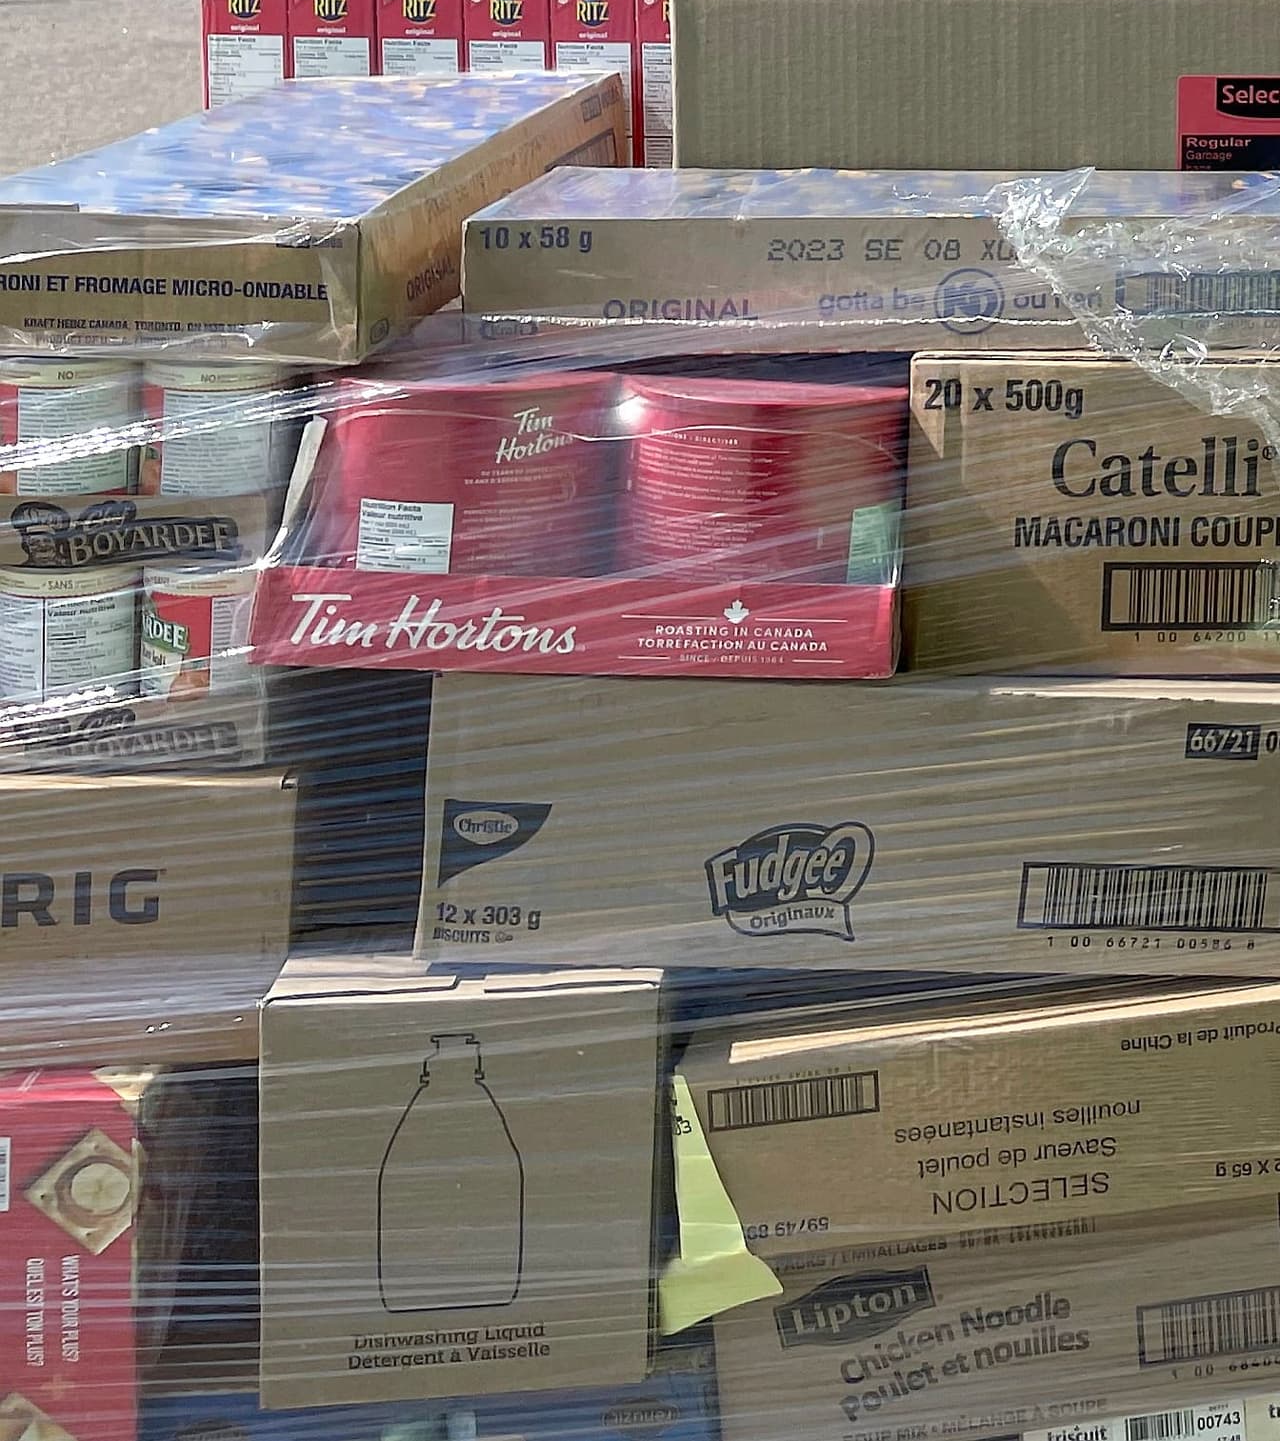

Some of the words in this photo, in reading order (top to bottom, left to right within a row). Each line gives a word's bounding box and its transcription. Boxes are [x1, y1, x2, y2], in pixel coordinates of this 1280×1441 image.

[576, 0, 609, 23] RITZ
[231, 25, 260, 33] original
[317, 27, 346, 35] original
[405, 28, 434, 36] original
[579, 31, 608, 39] original
[1186, 137, 1251, 148] Regular
[480, 227, 509, 249] 10
[519, 231, 531, 248] x
[540, 226, 569, 248] 58
[580, 231, 593, 253] g
[768, 239, 844, 261] 2023
[865, 239, 904, 261] SE
[925, 239, 960, 261] 08
[46, 275, 69, 292] ET
[75, 276, 166, 295] FROMAGE
[172, 279, 328, 300] MICRO-ONDABLE
[603, 298, 759, 321] ORIGINAL
[818, 290, 884, 317] gotta
[1013, 293, 1047, 309] ou
[57, 370, 74, 380] NO
[200, 373, 216, 383] NO
[924, 379, 962, 411] 20
[973, 387, 994, 411] x
[1005, 379, 1084, 419] 500g
[513, 407, 553, 435] Tim
[496, 434, 574, 464] Hortons
[1051, 436, 1263, 499] Catelli
[1015, 516, 1180, 548] MACARONI
[48, 580, 73, 590] SANS
[292, 593, 376, 647] Tim
[384, 594, 578, 655] Hortons
[655, 625, 729, 637] ROASTING
[734, 626, 748, 637] IN
[754, 627, 813, 638] CANADA
[748, 641, 767, 651] AU
[770, 641, 828, 652] CANADA
[1193, 631, 1246, 642] 64200
[679, 654, 710, 663] SINCE
[721, 655, 758, 664] DEPUIS
[1189, 726, 1257, 754] 66721
[458, 815, 513, 835] Christie
[436, 903, 457, 924] 12
[463, 910, 476, 925] x
[483, 904, 522, 926] 303
[528, 909, 541, 931] g
[750, 906, 835, 930] Originaux
[433, 926, 491, 943] BISCUITS
[1071, 936, 1092, 948] 00
[1106, 936, 1161, 949] 66721
[1121, 1032, 1172, 1051] Chine
[1178, 1030, 1192, 1046] la
[1197, 1025, 1217, 1042] de
[1053, 1098, 1141, 1125] nouilles
[894, 1112, 1045, 1144] instantanées
[998, 1147, 1027, 1167] de
[1036, 1135, 1118, 1162] Saveur
[917, 1146, 990, 1178] poulet
[1215, 1160, 1227, 1176] g
[1231, 1162, 1254, 1178] 65
[932, 1171, 1111, 1216] SELECTION
[27, 1258, 44, 1286] QUEL
[62, 1298, 79, 1328] YOUR
[790, 1281, 917, 1336] Lipton
[27, 1312, 44, 1332] TON
[27, 1332, 44, 1366] PLUS?
[62, 1329, 80, 1362] PLUS?
[840, 1322, 955, 1385] Chicken
[959, 1292, 1072, 1336] Noodle
[467, 1340, 551, 1363] Vaisselle
[941, 1351, 971, 1377] et
[974, 1326, 1091, 1368] nouilles
[1196, 1410, 1242, 1431] 00743
